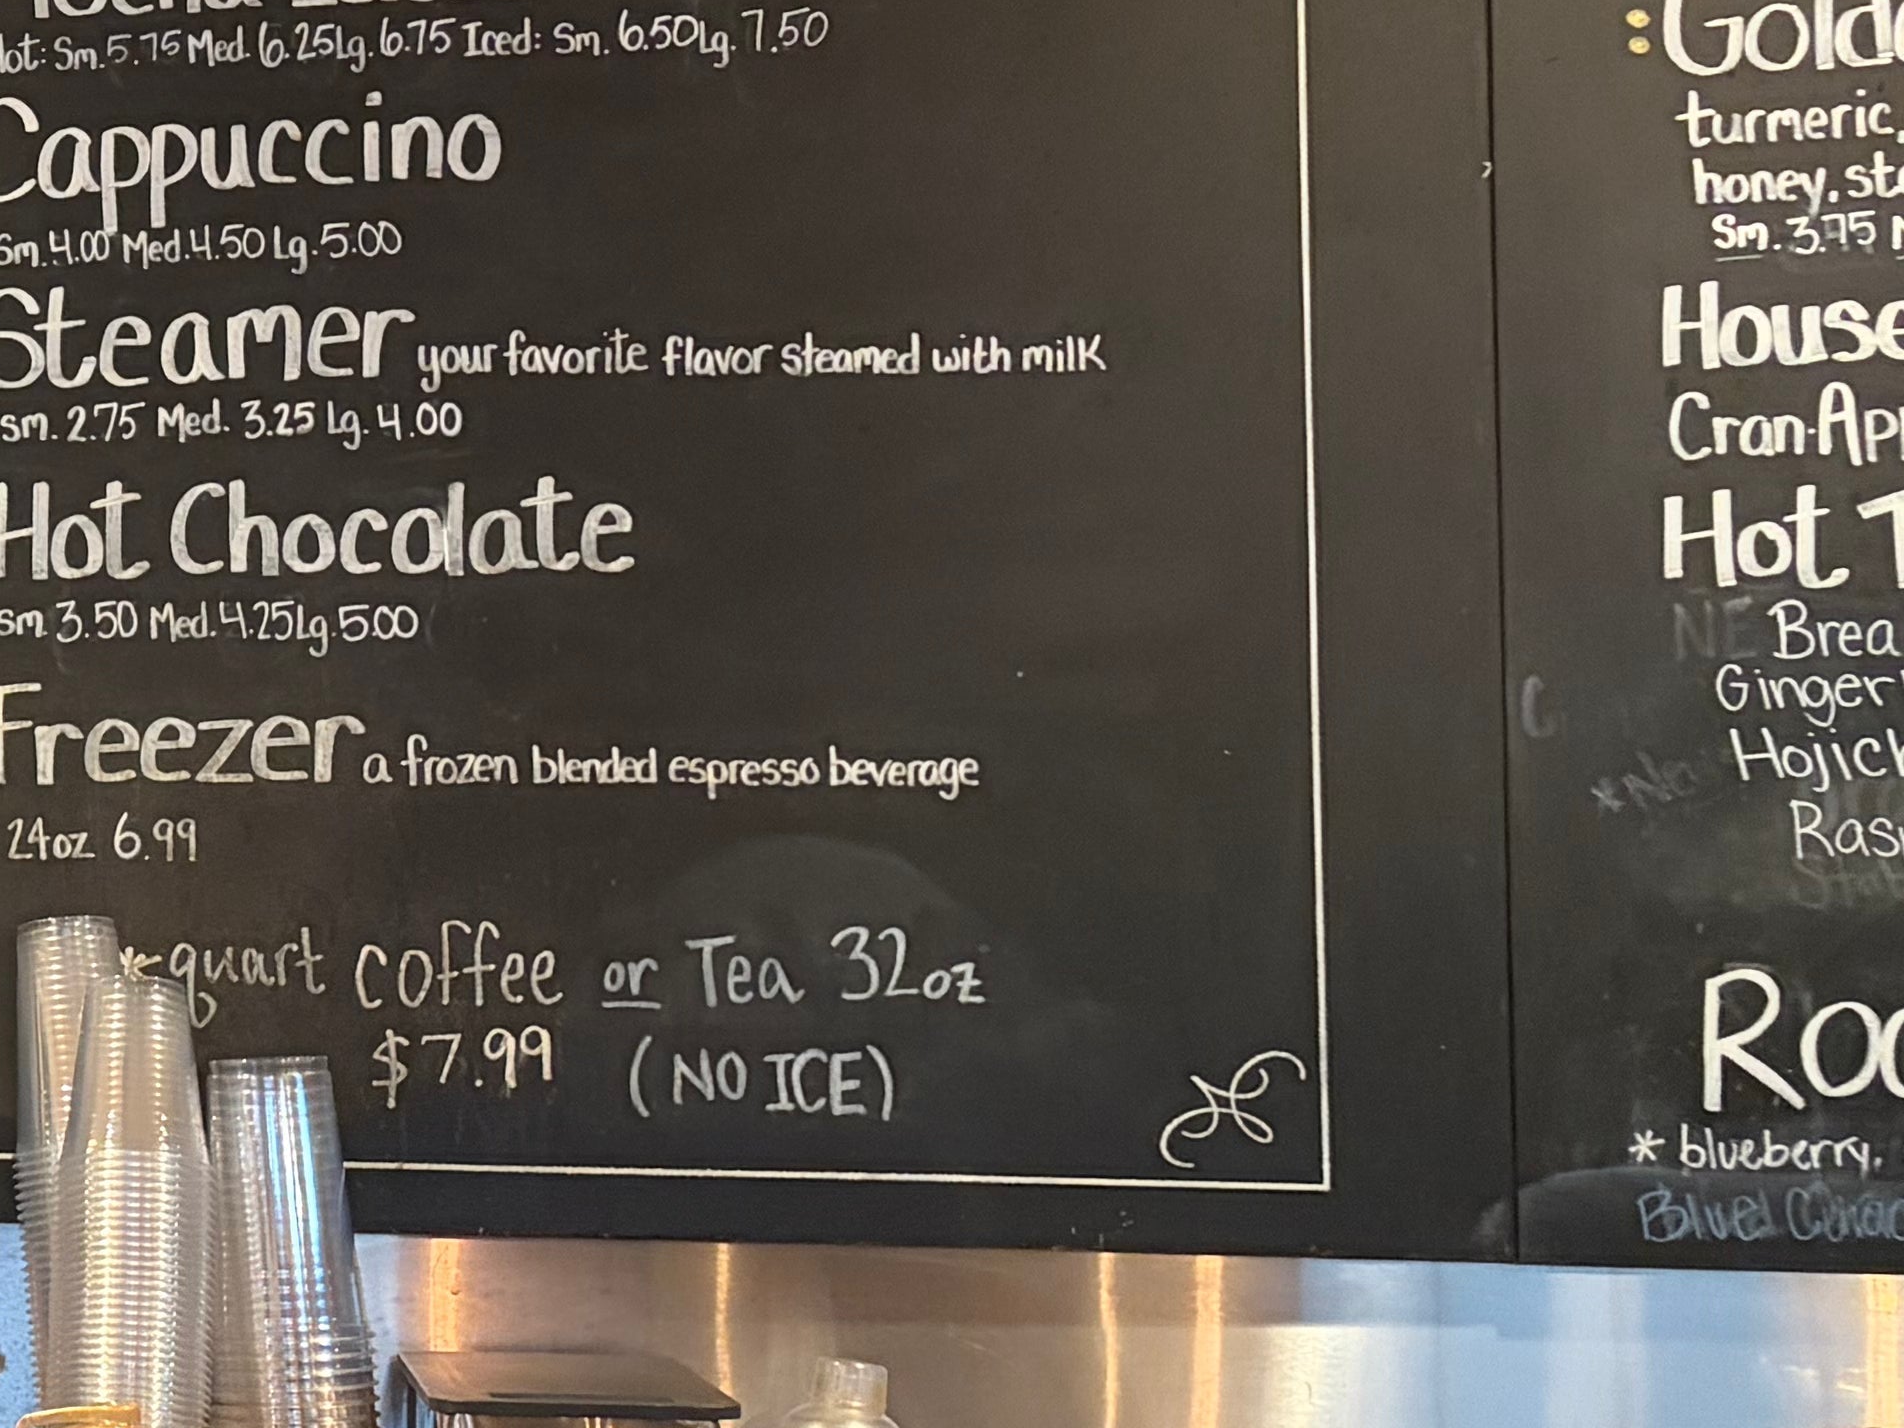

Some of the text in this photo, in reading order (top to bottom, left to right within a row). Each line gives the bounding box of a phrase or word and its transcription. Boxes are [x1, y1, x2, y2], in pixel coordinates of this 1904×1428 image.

[418, 344, 497, 392] your
[503, 328, 648, 376] favorite
[662, 336, 773, 376] flavor
[782, 332, 919, 376] steamed
[933, 334, 1011, 373] with
[68, 402, 145, 441] 2.75
[158, 398, 229, 443] Med.
[241, 400, 315, 439] 3.25
[328, 401, 369, 450] Lg.
[377, 402, 462, 440] 4.00
[170, 476, 634, 576] Chocolate
[1662, 483, 1851, 589] Hot
[1714, 662, 1896, 729] Ginger
[363, 751, 394, 786] a
[400, 734, 518, 786] frozen
[532, 745, 657, 783] blended
[669, 756, 820, 799] espresso
[829, 746, 979, 800] beverage
[8, 812, 196, 861] 24oz 6.99
[168, 920, 985, 1030] quart coffee or Tea 32oz
[372, 1026, 552, 1108] $7.99
